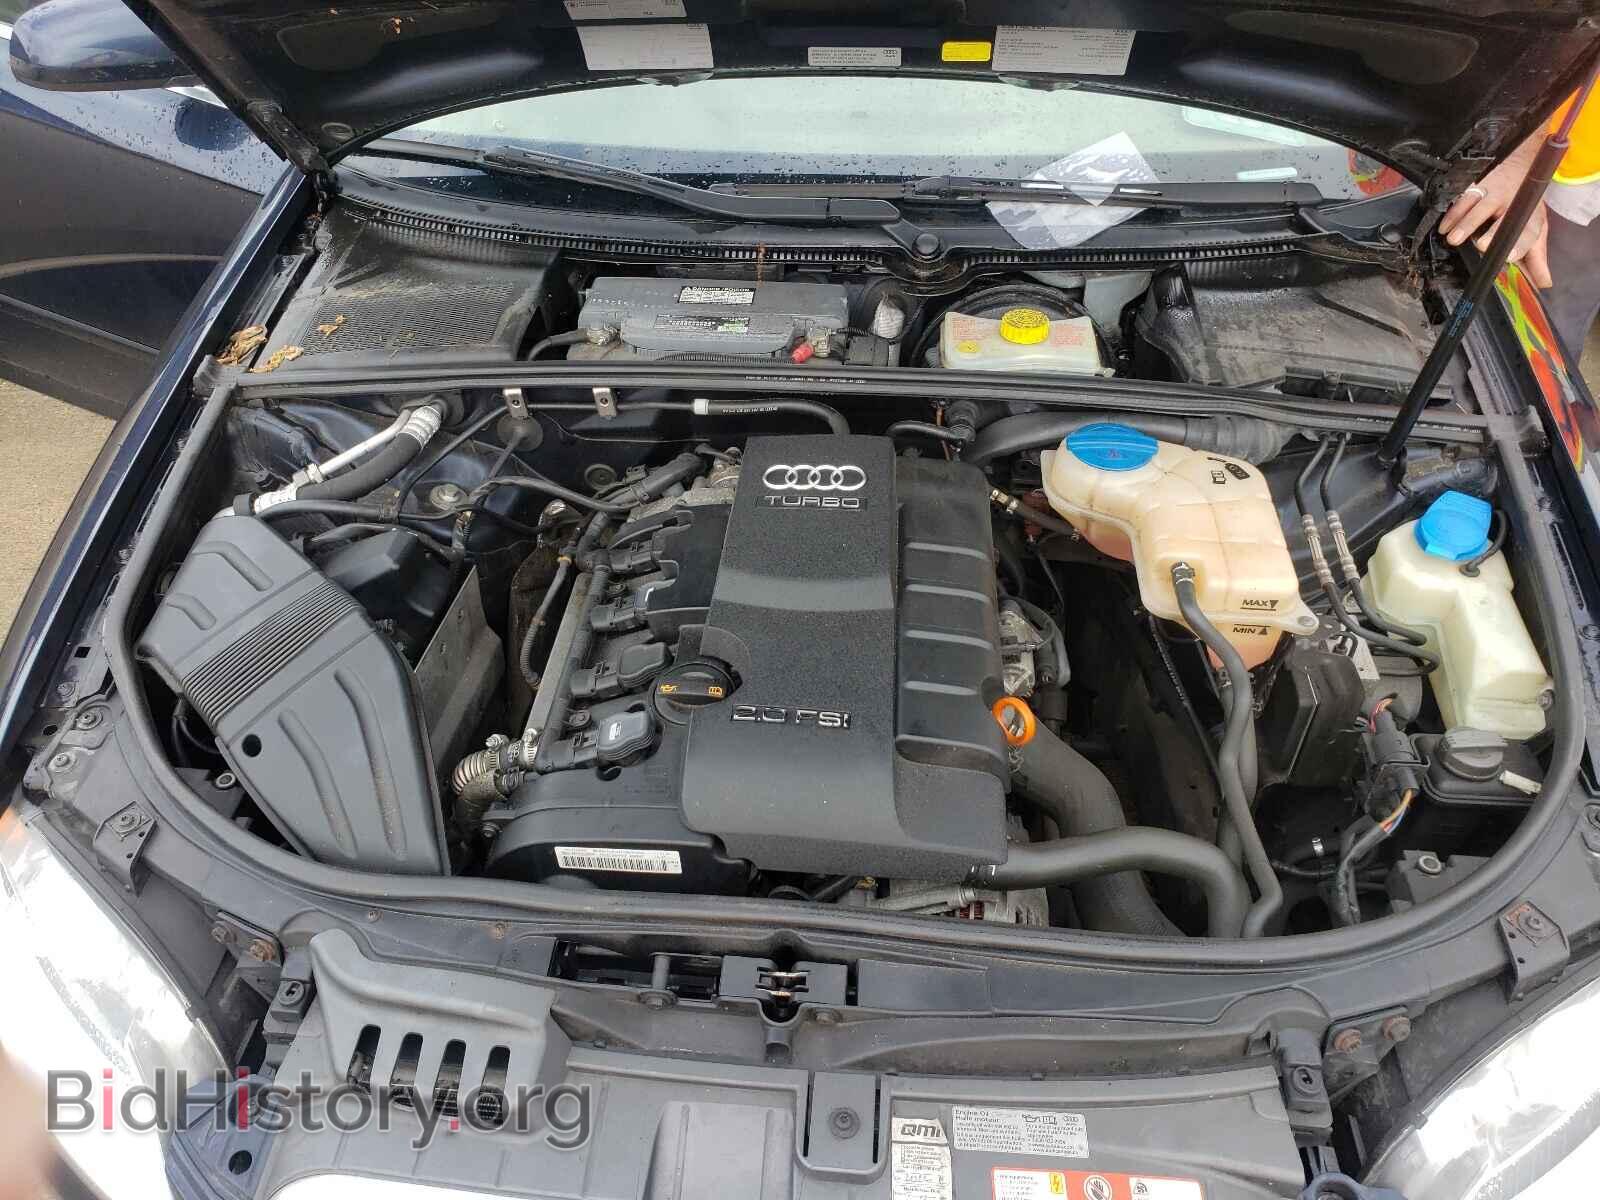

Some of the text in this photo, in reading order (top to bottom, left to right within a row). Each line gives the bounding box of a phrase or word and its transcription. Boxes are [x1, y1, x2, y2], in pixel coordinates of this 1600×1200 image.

[764, 495, 860, 508] TURBO
[733, 705, 849, 728] 2.0 FSI
